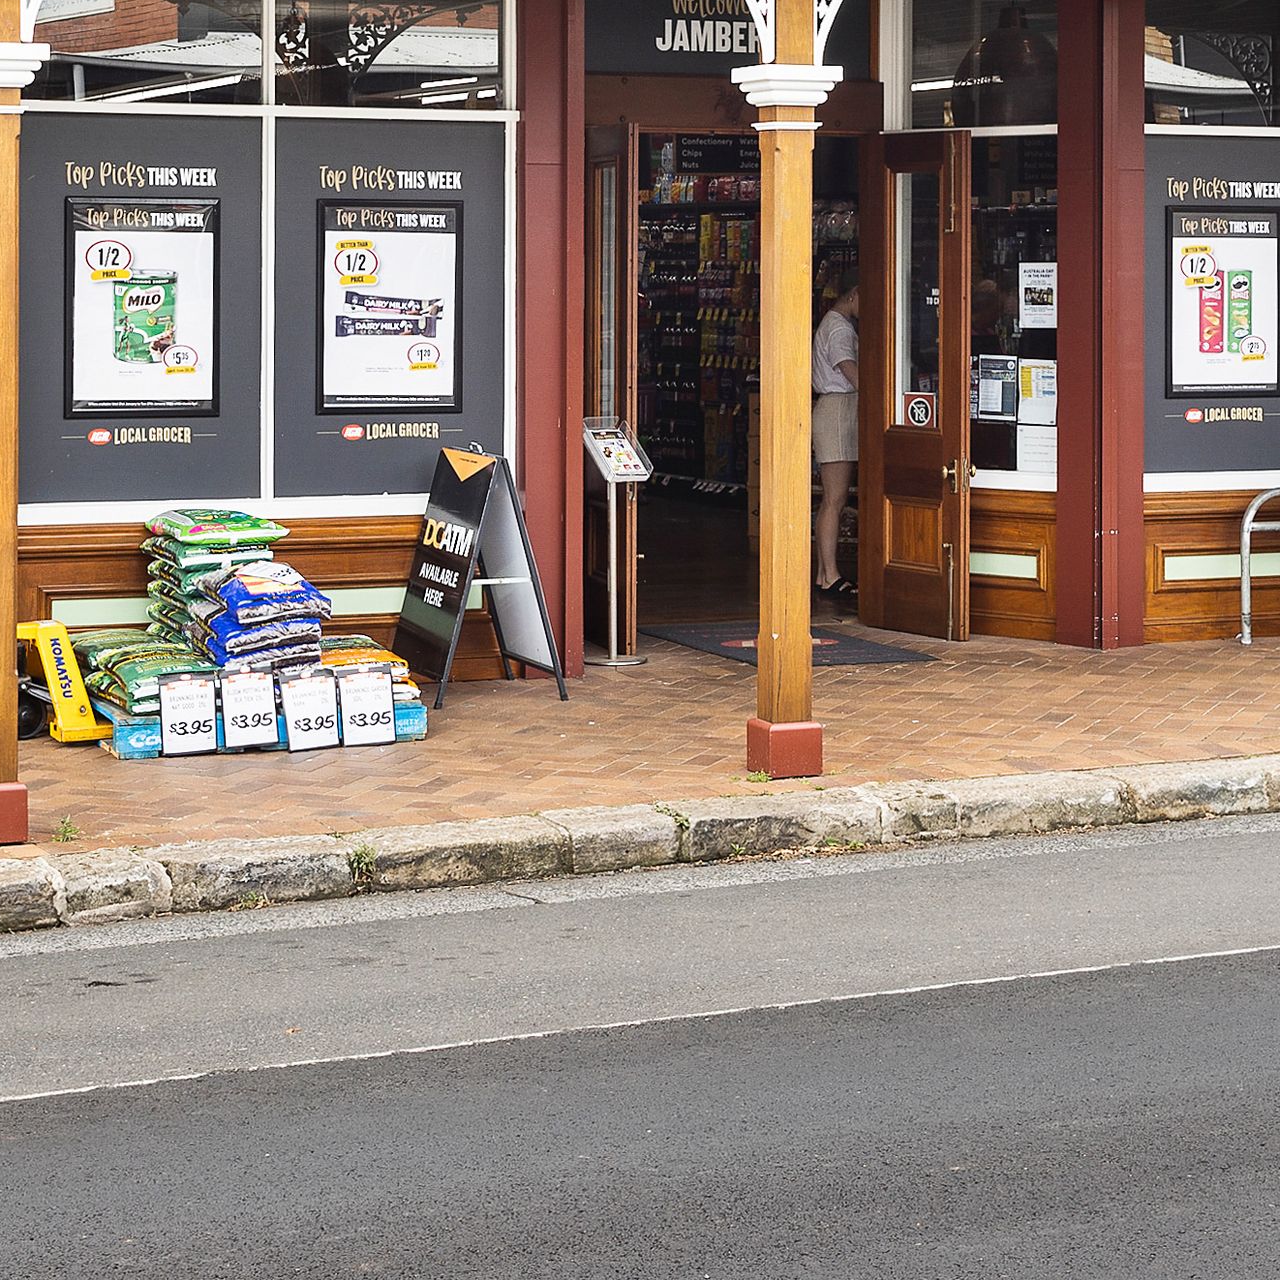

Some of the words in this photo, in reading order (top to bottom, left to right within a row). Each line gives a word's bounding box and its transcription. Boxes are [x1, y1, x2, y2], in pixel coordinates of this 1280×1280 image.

[656, 19, 760, 53] JAMBER
[681, 138, 733, 146] Confectionery
[681, 149, 702, 157] Chips
[65, 162, 93, 189] Top
[100, 162, 145, 187] Picks
[147, 167, 179, 186] THIS
[180, 167, 217, 186] WEEK
[320, 166, 347, 192] Top
[352, 166, 395, 191] Picks
[396, 171, 425, 190] THIS
[427, 171, 462, 190] WEEK
[1167, 177, 1189, 201] Top
[1193, 177, 1228, 199] Picks
[1229, 182, 1253, 198] THIS
[1253, 182, 1280, 198] WEEK
[86, 208, 109, 228] Top
[113, 208, 149, 227] Picks
[150, 213, 175, 227] THIS
[175, 213, 204, 227] WEEK
[336, 209, 357, 229] Top
[361, 209, 395, 228] Picks
[395, 213, 419, 227] THIS
[419, 214, 446, 228] WEEK
[1181, 218, 1199, 235] Top
[1201, 217, 1228, 234] Picks
[1229, 221, 1248, 233] THIS
[1248, 221, 1270, 234] WEEK
[98, 246, 120, 267] 1/2
[346, 252, 366, 272] 1/2
[1190, 257, 1206, 274] 1/2
[128, 294, 161, 306] MILO
[364, 300, 388, 309] DAIRY
[389, 301, 409, 310] MILK
[355, 321, 380, 330] DAIRY
[380, 322, 401, 330] MILK
[1205, 408, 1230, 422] LOCAL
[1231, 407, 1263, 422] GROCER
[114, 428, 150, 445] LOCAL
[150, 427, 191, 443] GROCER
[366, 423, 398, 440] LOCAL
[398, 422, 439, 439] GROCER
[419, 562, 459, 588] AVAILABLE
[423, 587, 444, 608] HERE
[50, 637, 73, 698] KOMATSU
[169, 719, 214, 735] $3.95
[231, 712, 273, 728] $3.95
[294, 714, 335, 732] $3.95
[349, 711, 391, 727] $3.95
